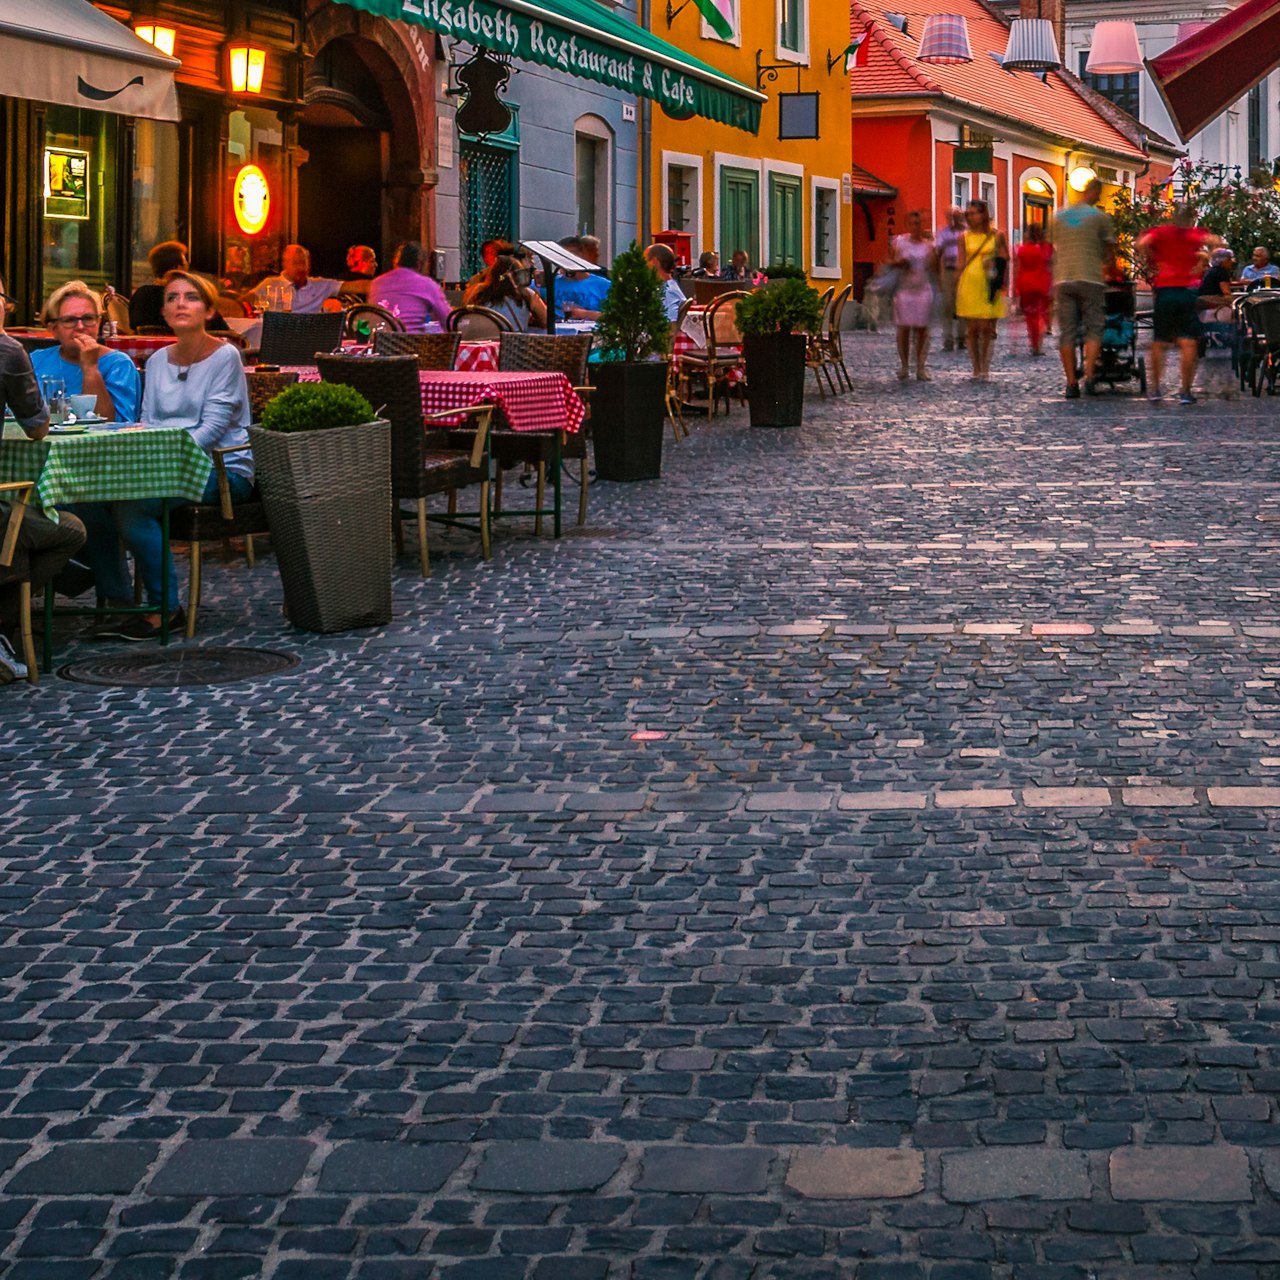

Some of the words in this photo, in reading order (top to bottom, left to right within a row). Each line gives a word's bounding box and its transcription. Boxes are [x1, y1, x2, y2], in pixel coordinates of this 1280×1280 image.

[530, 20, 635, 84] Restaurant
[642, 62, 654, 91] &
[661, 68, 695, 107] Cafe
[886, 207, 896, 238] GAL
